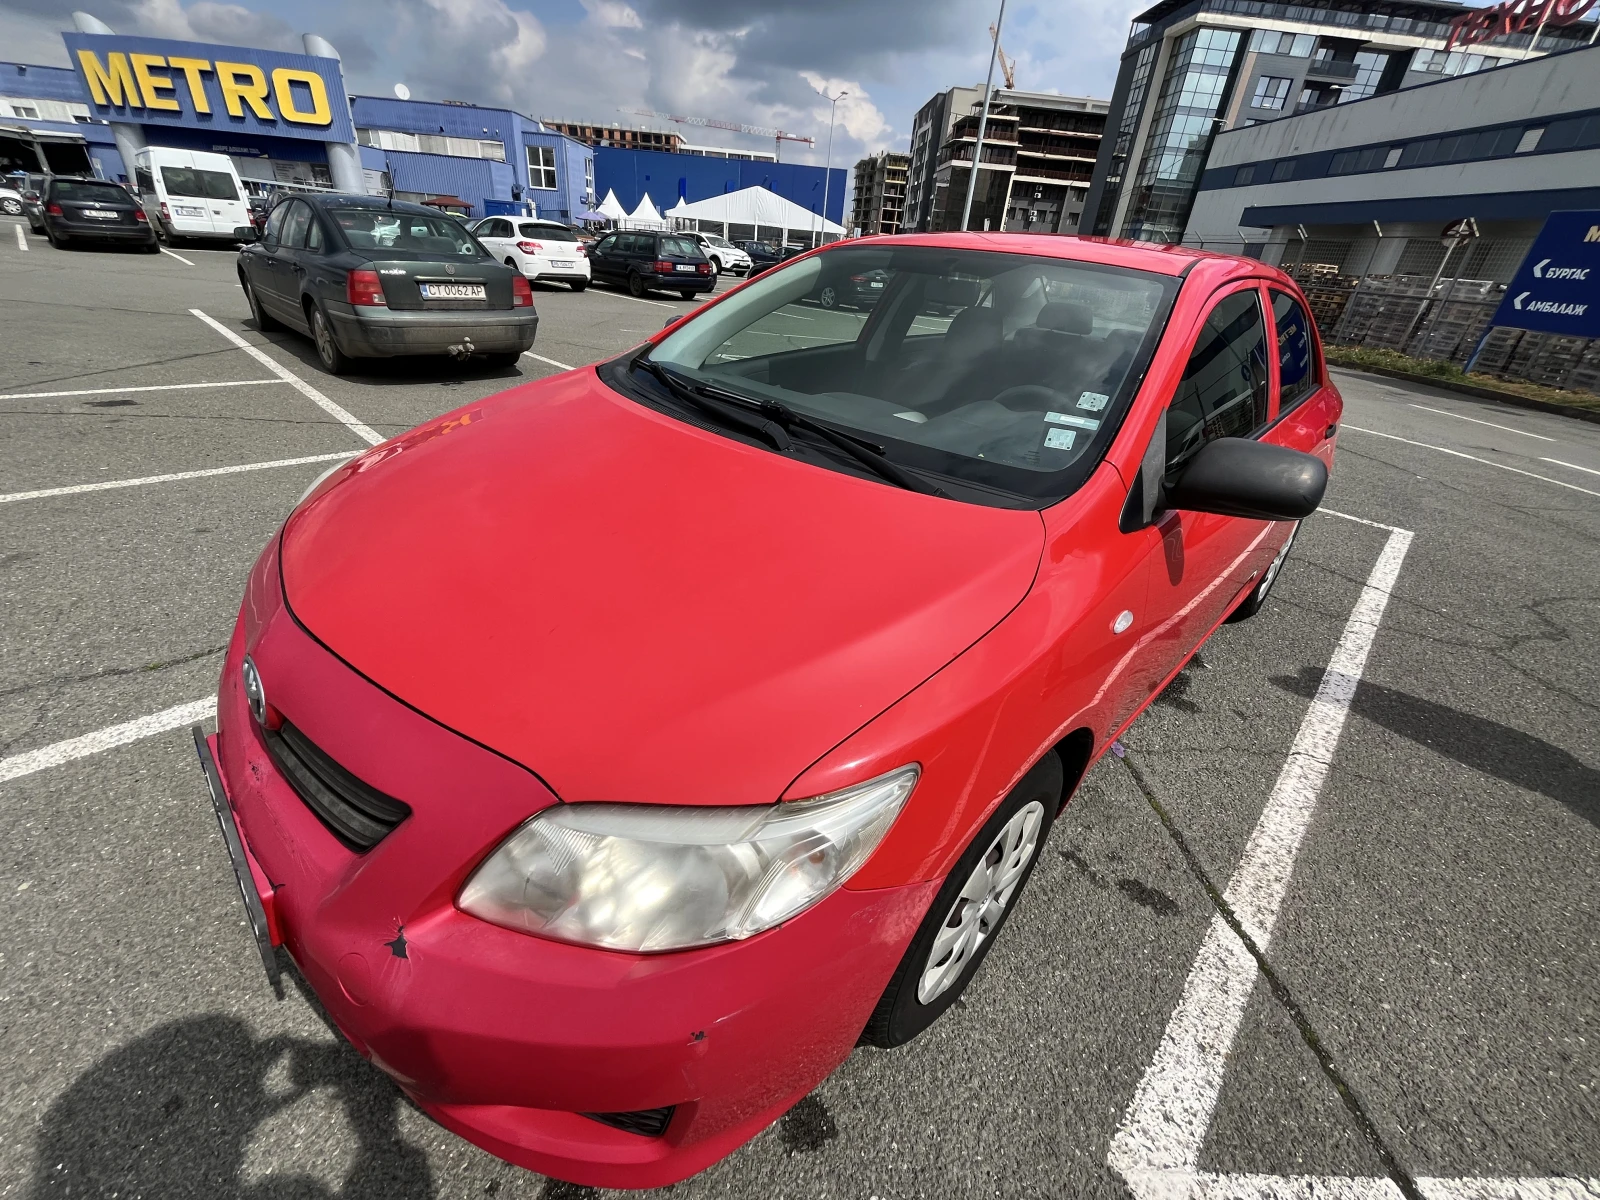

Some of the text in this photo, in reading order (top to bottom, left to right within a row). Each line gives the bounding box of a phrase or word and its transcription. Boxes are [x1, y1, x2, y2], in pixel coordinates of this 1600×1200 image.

[77, 50, 332, 125] METRO
[1545, 268, 1590, 280] БУРГАС
[428, 284, 482, 296] CT 0062 AP
[1526, 301, 1588, 315] АМБАЛАЖ
